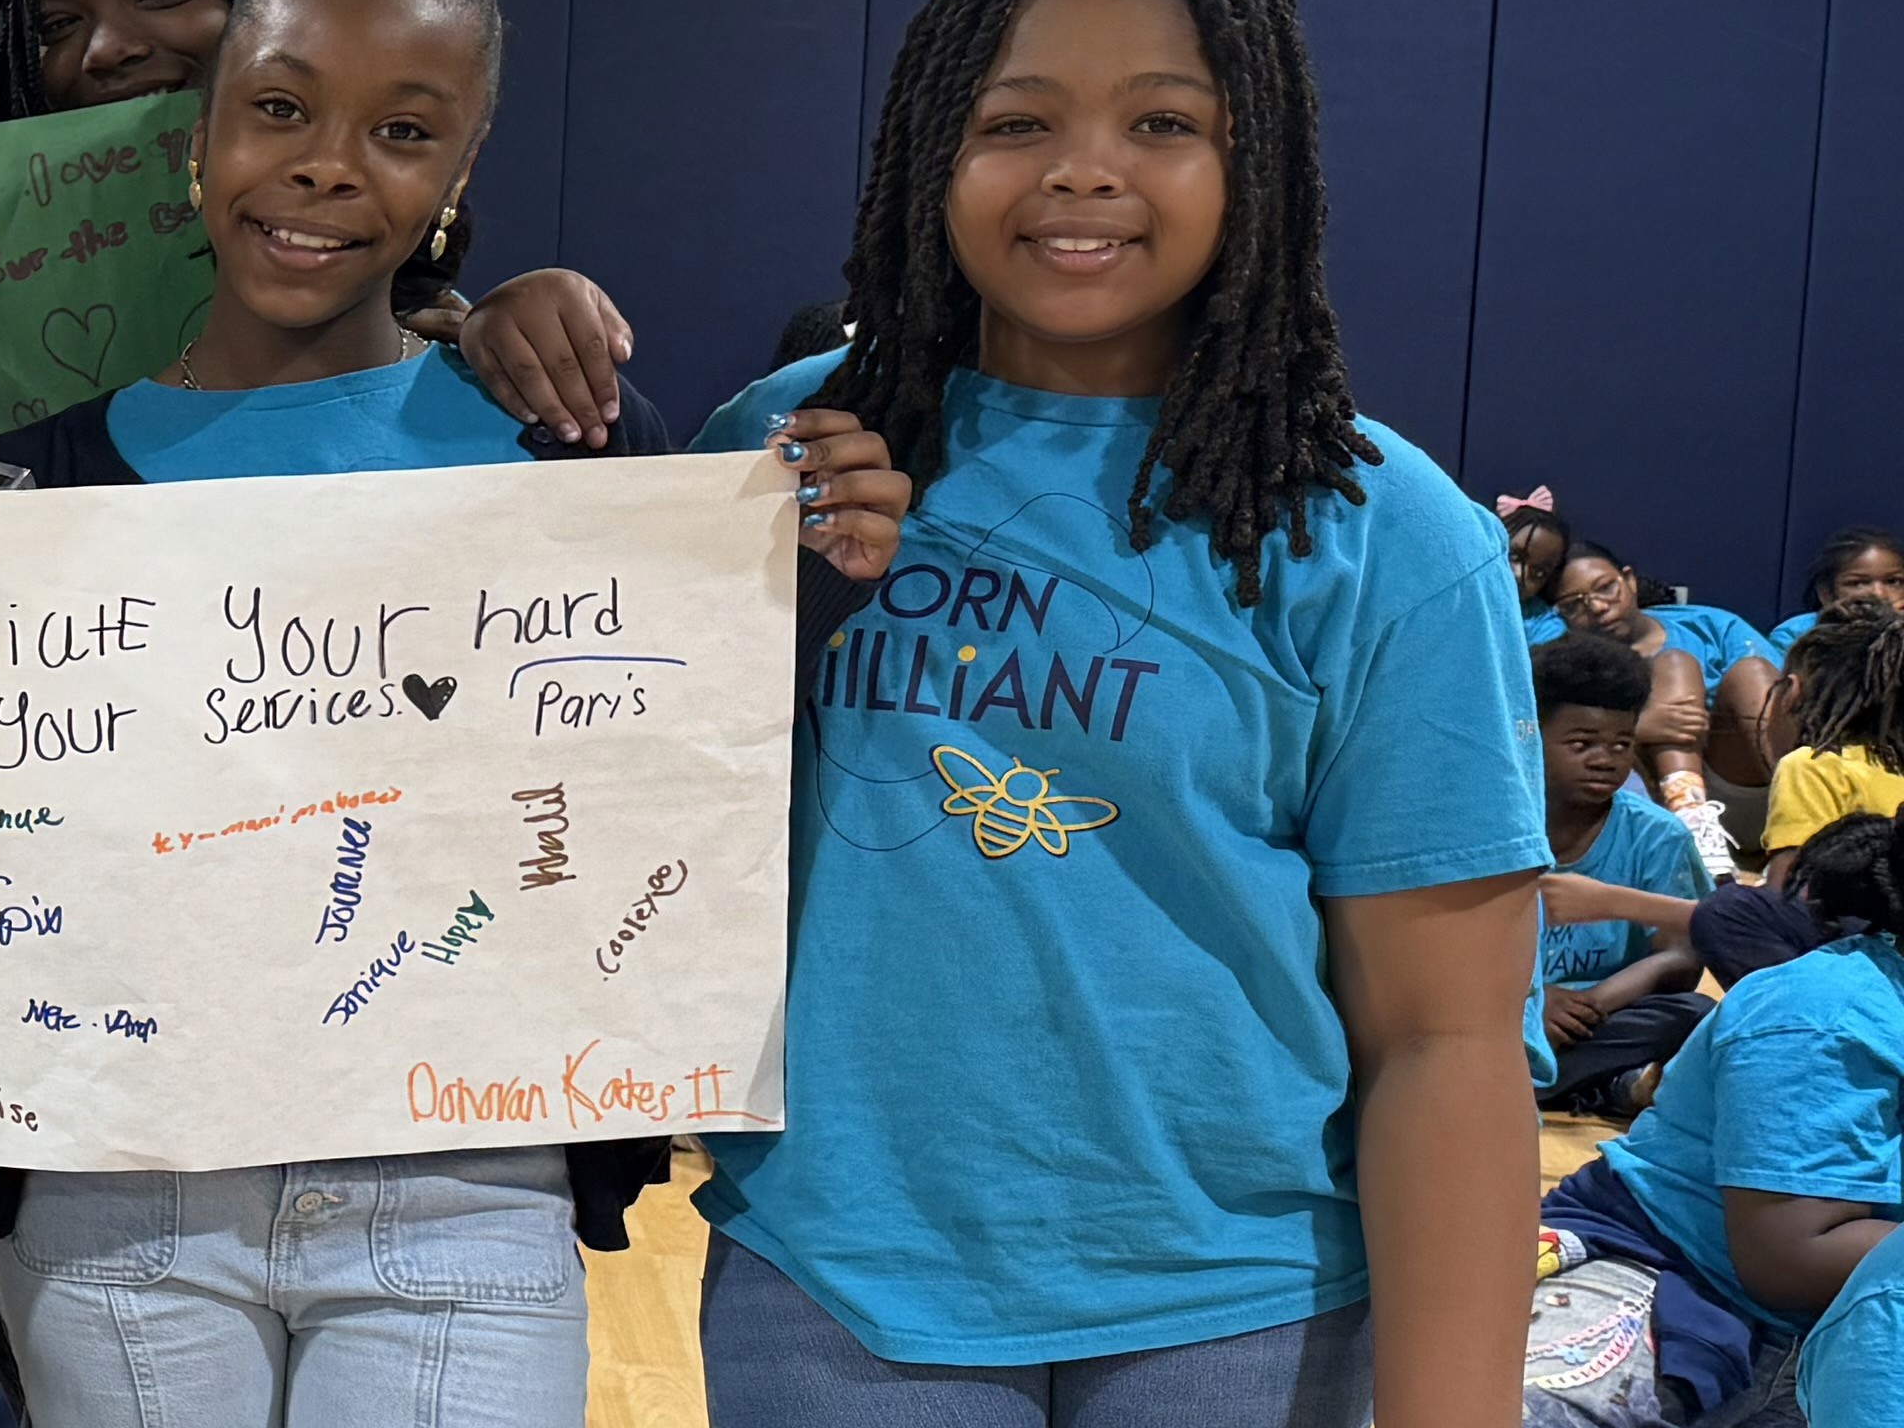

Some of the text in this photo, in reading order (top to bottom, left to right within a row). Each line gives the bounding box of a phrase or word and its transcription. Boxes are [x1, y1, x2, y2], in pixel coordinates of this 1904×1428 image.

[30, 144, 143, 206] love
[61, 220, 128, 263] the
[474, 577, 622, 650] hard
[421, 900, 486, 965] Hope
